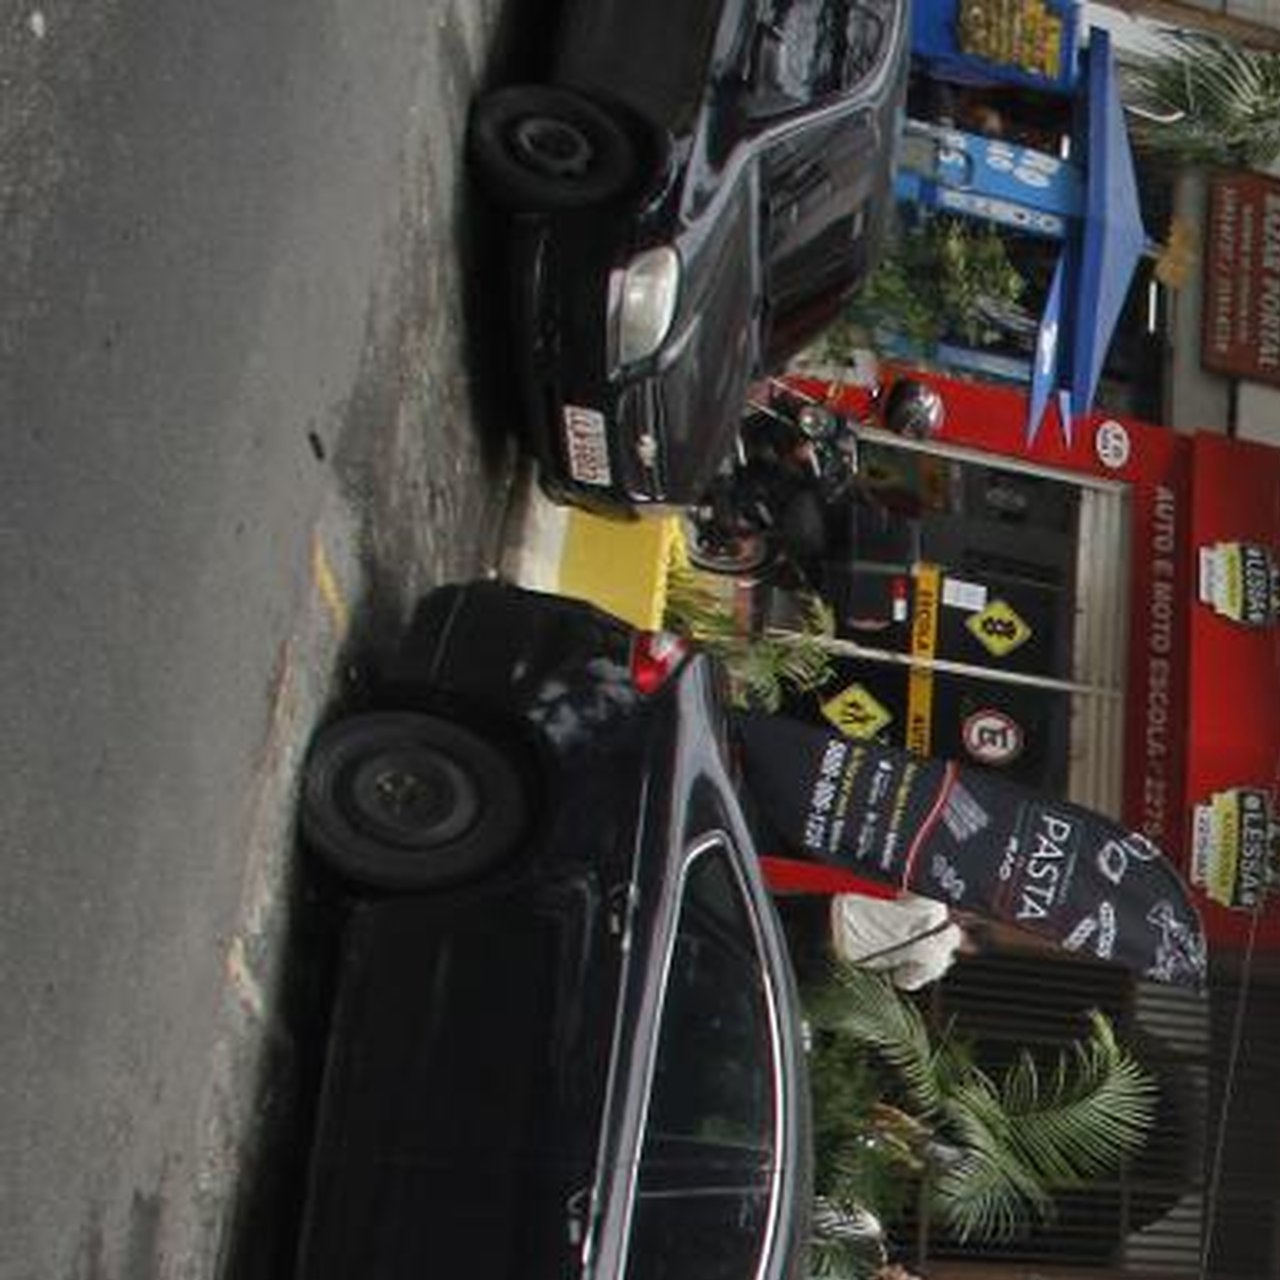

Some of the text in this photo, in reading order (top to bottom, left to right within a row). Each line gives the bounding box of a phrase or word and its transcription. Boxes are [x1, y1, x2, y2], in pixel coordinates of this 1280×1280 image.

[1152, 485, 1176, 553] AUTO
[1152, 558, 1175, 577] E
[1245, 558, 1267, 611] LESSA
[916, 588, 935, 651] ESCOLA
[1148, 581, 1173, 654] MOTO
[1146, 657, 1169, 758] ESCOLA
[1015, 814, 1072, 921] PASTA
[1239, 812, 1264, 889] LESSA
